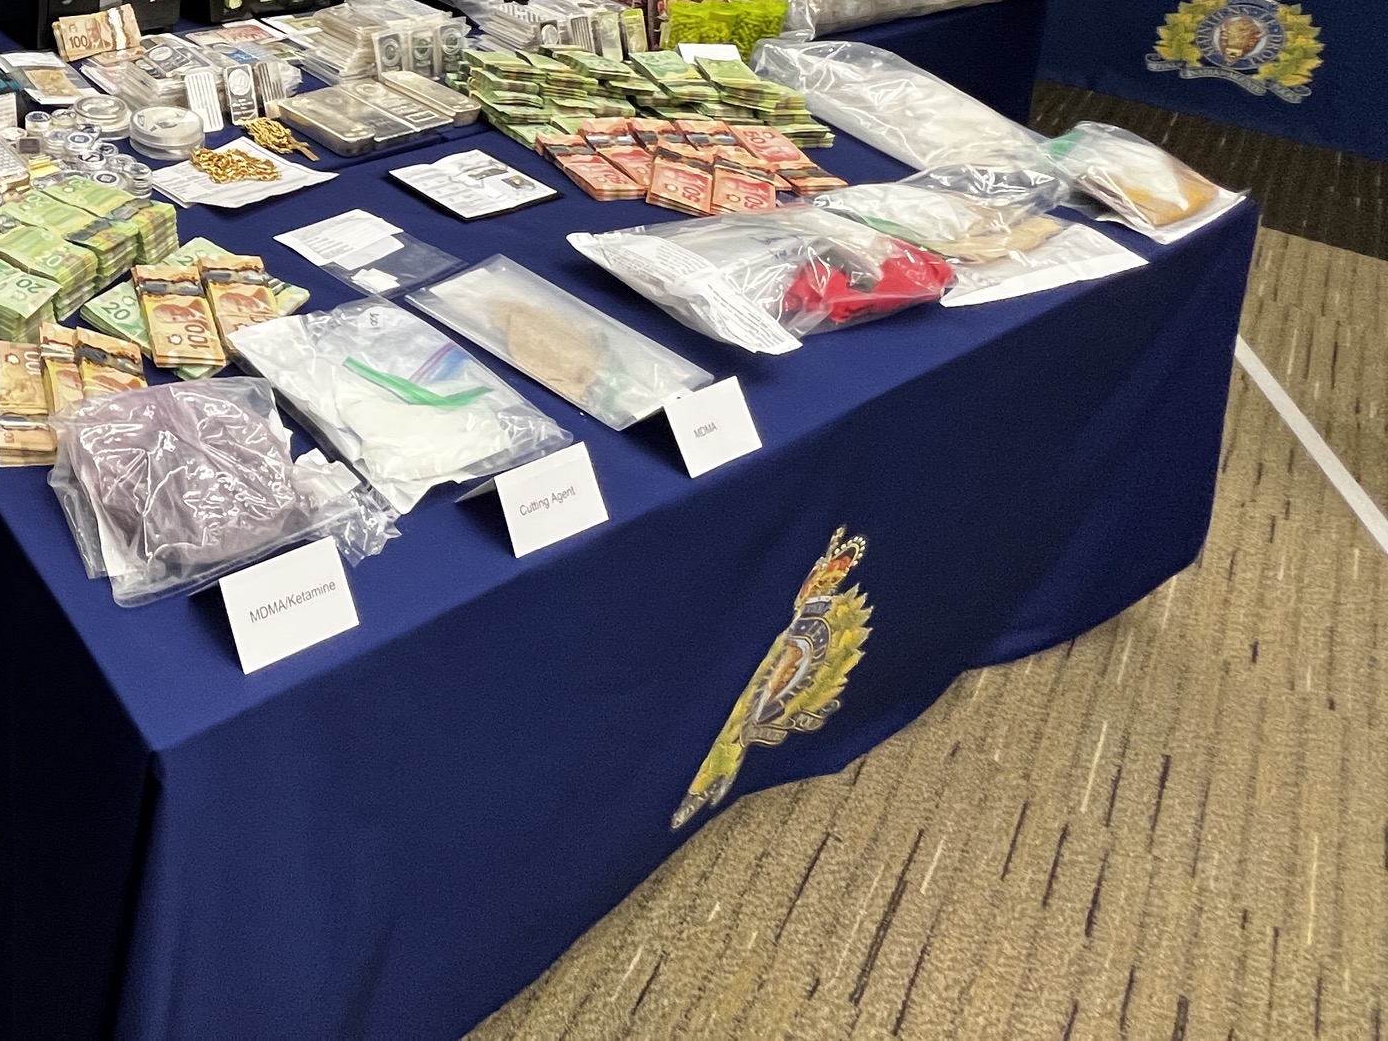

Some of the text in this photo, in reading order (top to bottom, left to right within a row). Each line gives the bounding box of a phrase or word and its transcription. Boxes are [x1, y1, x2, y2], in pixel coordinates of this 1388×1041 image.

[68, 35, 90, 50] 100
[16, 279, 47, 294] 20
[100, 301, 131, 321] 20
[184, 324, 210, 349] 100
[693, 422, 718, 440] MDMA
[519, 485, 576, 517] Cutting Agent
[249, 579, 336, 623] MDMA/Ketamine
